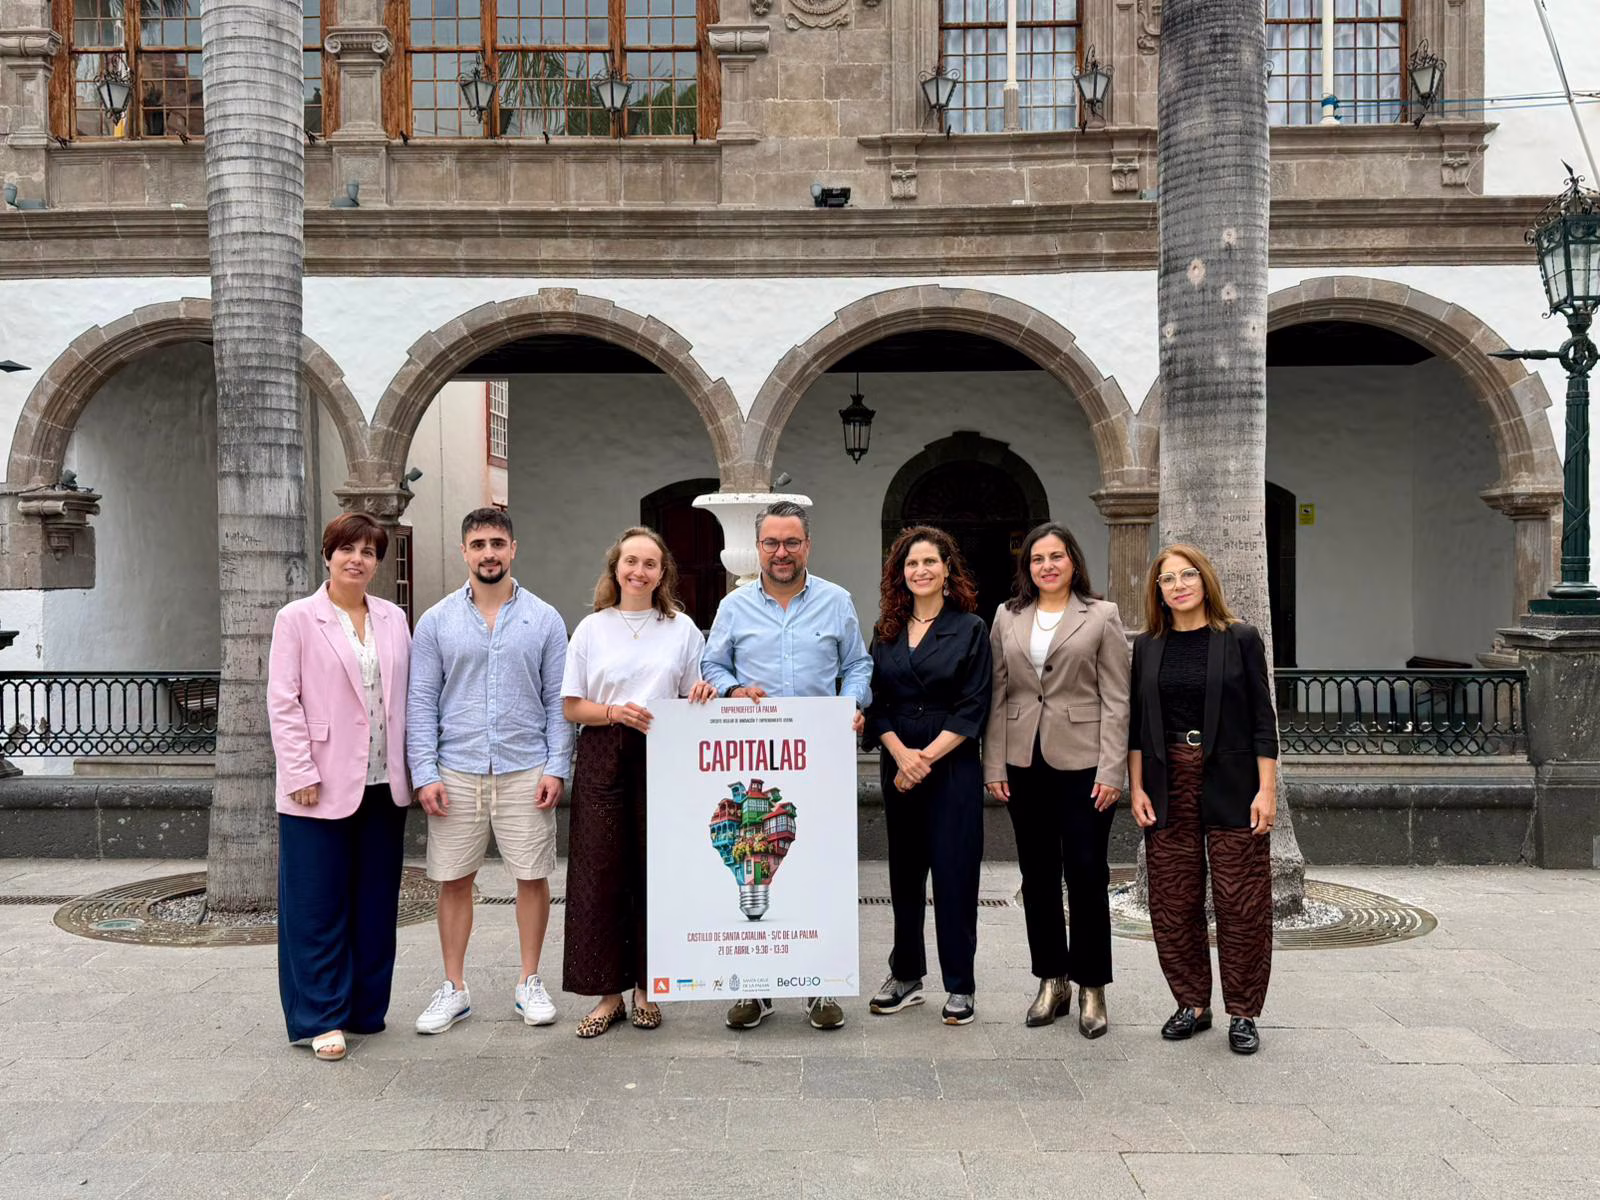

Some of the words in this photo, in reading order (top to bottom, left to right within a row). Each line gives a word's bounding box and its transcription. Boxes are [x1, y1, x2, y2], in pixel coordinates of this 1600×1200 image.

[762, 705, 778, 713] PALMA
[699, 739, 806, 772] CAPITALAB
[687, 932, 712, 942] CASTILLO
[714, 932, 721, 941] DE
[722, 931, 740, 941] SANTA
[741, 931, 766, 941] CATALINA
[771, 930, 781, 940] S/C
[783, 930, 790, 940] DE
[791, 930, 798, 939] LA
[799, 930, 818, 939] PALMA
[726, 946, 733, 955] DE
[734, 945, 750, 955] ABRIL
